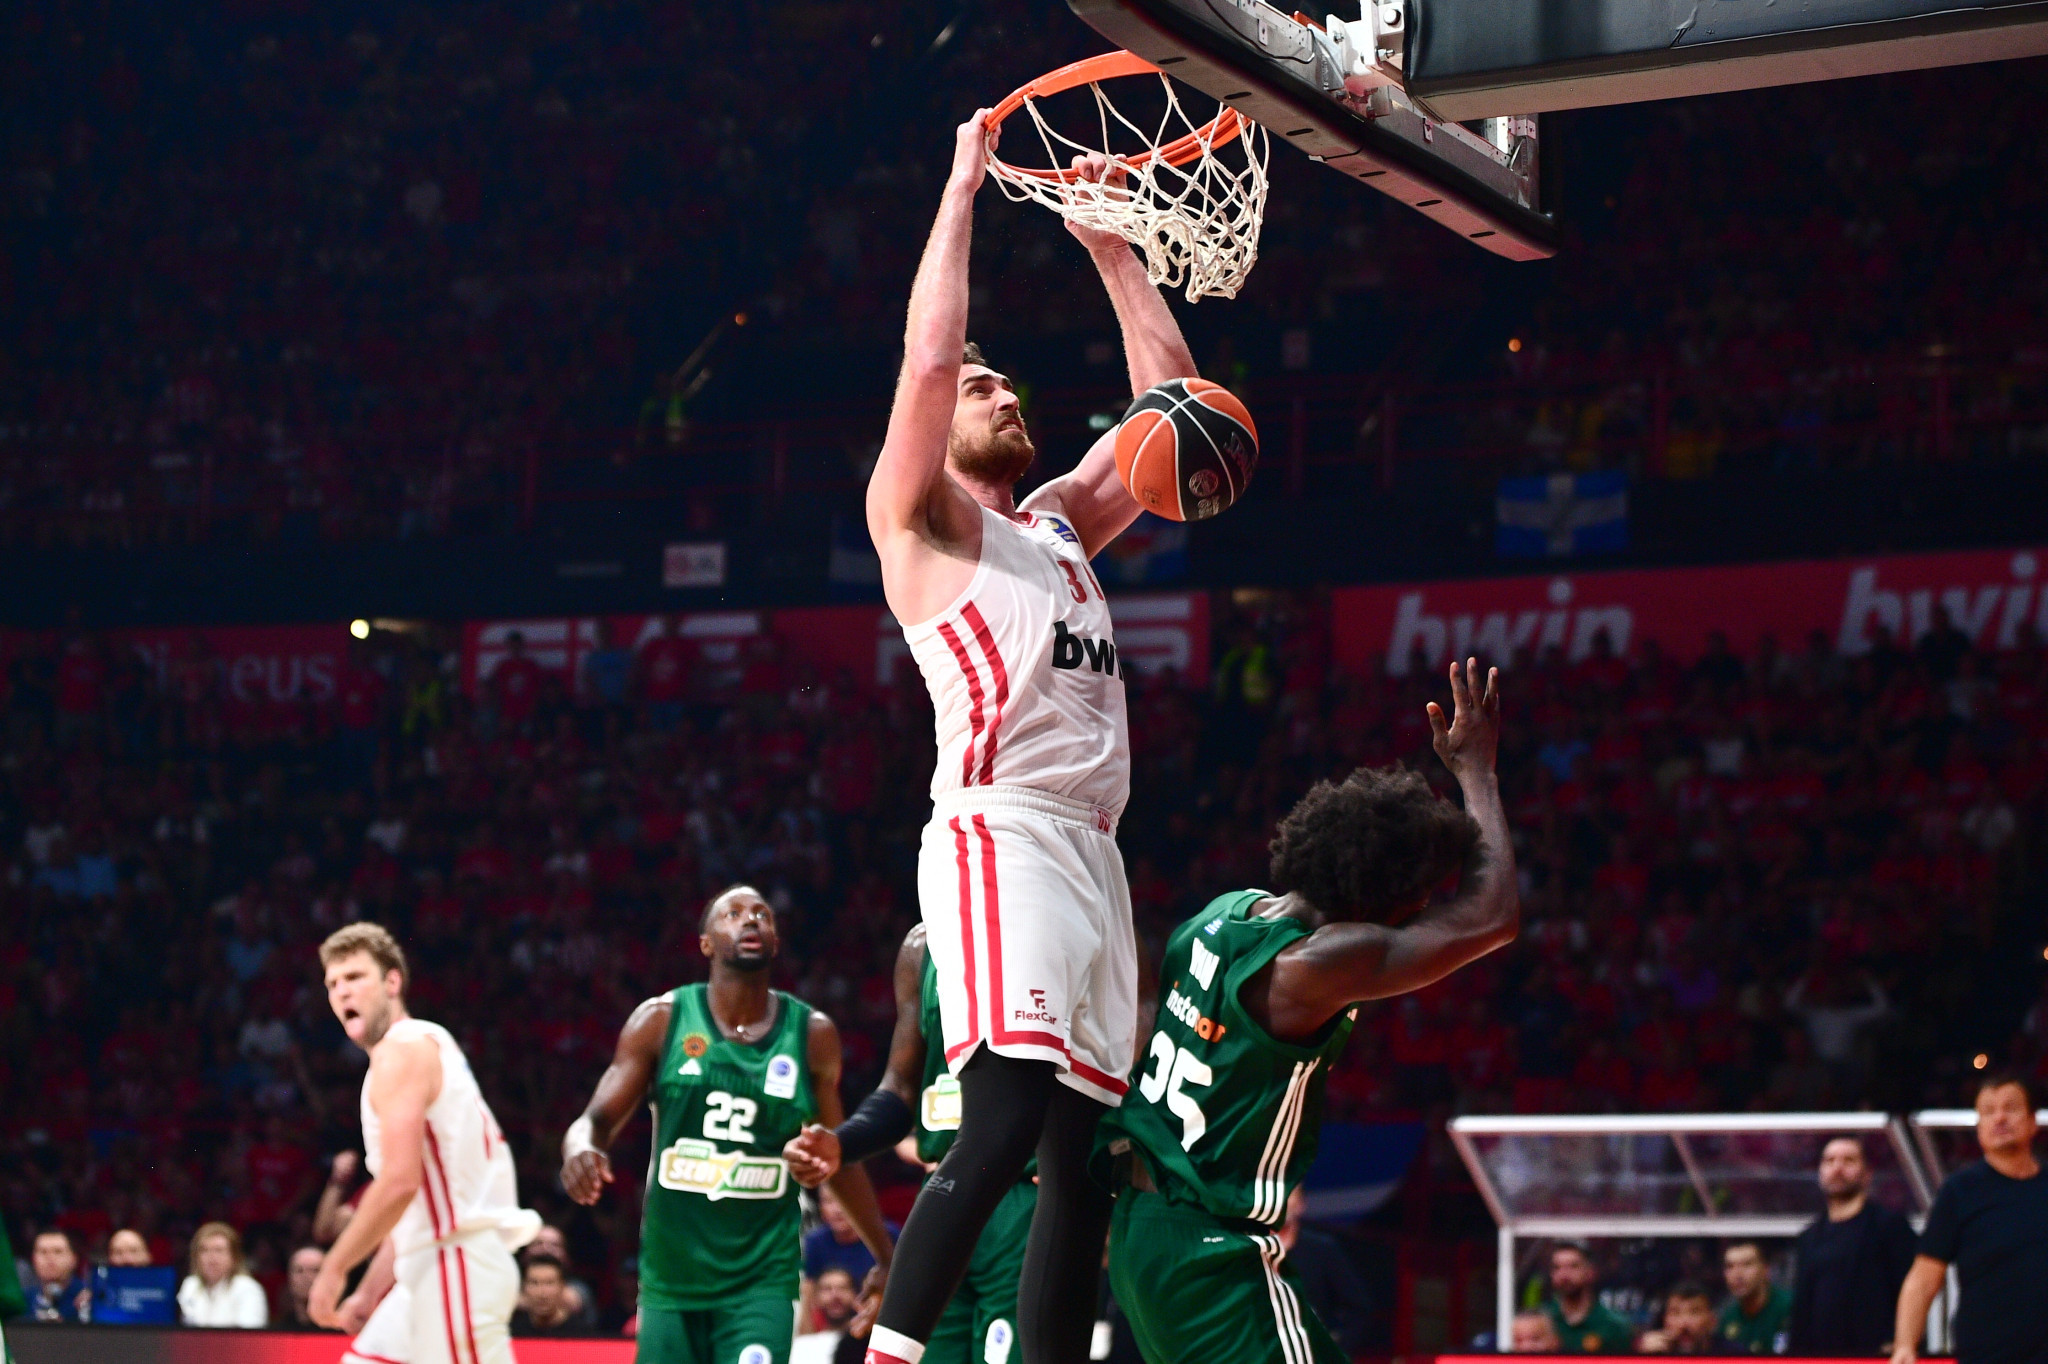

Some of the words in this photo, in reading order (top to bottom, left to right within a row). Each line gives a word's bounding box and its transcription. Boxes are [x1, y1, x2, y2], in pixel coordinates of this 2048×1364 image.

[1386, 577, 1632, 675] bwin
[1836, 552, 2048, 655] bwi
[1052, 620, 1124, 681] bw
[1015, 1010, 1057, 1025] FlexCar
[1166, 981, 1226, 1043] instaar
[703, 1090, 757, 1144] 22
